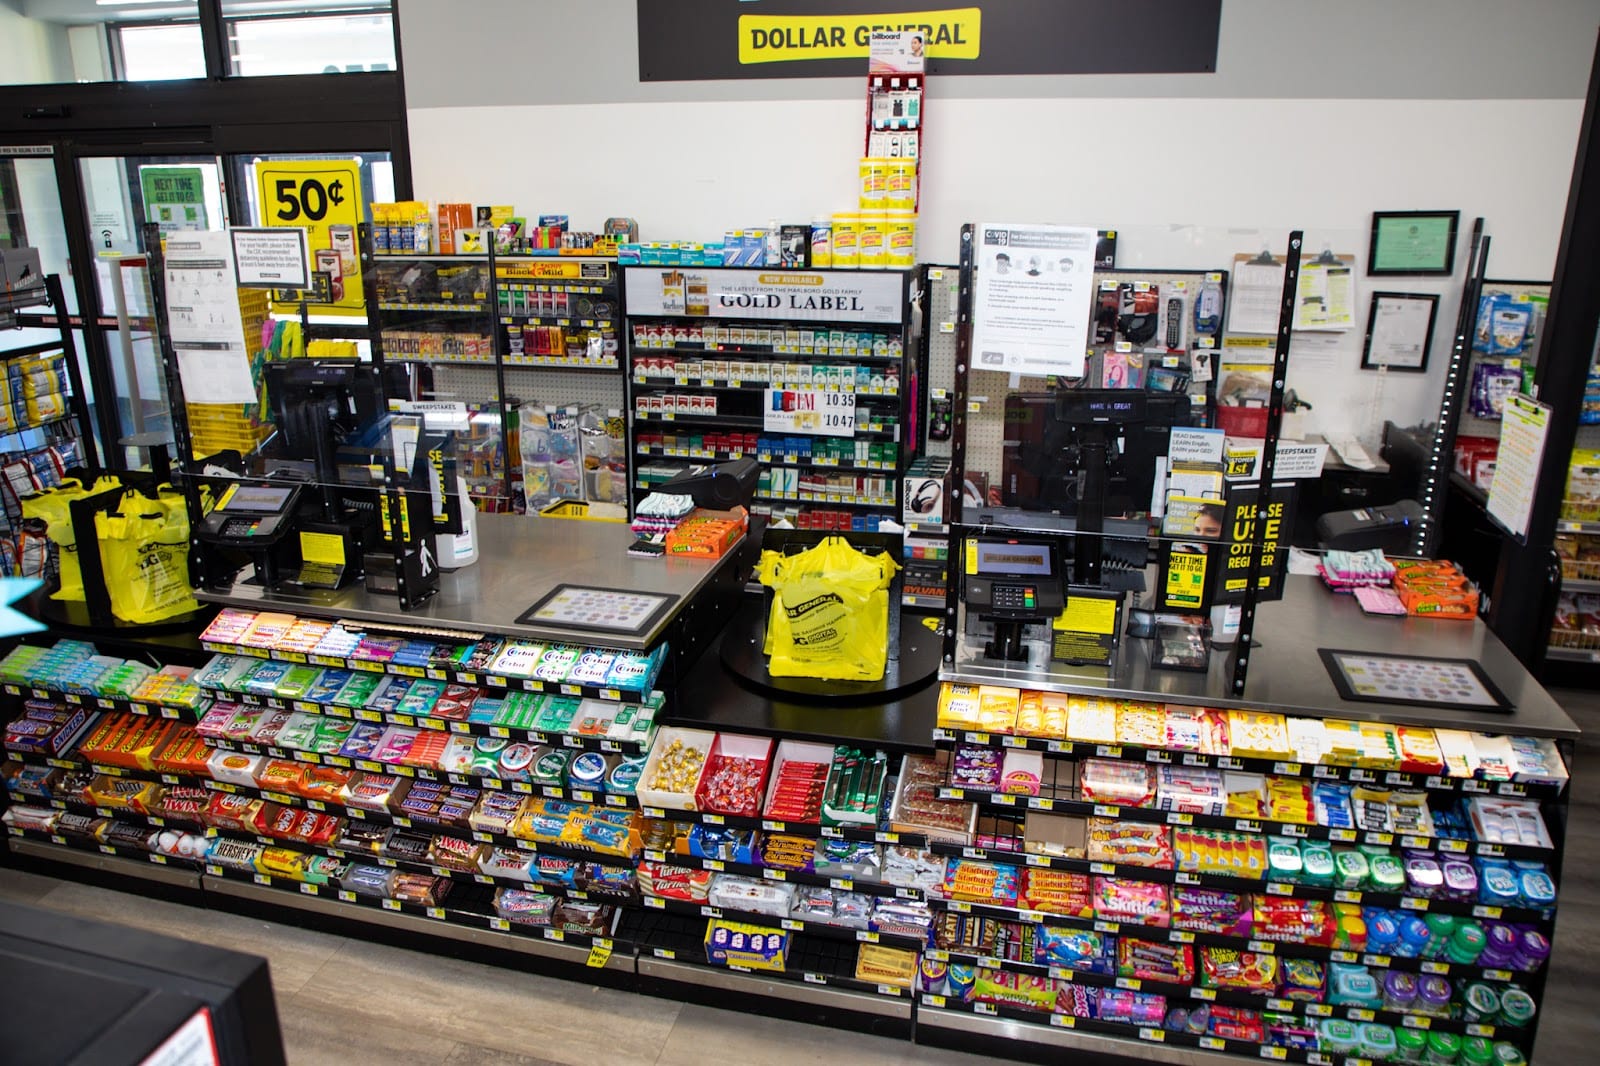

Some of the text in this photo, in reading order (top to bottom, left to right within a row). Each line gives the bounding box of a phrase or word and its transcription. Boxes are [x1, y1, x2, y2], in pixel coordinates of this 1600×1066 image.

[751, 23, 966, 49] DOLLAR GRAL
[154, 178, 193, 190] NEXT TIME
[276, 179, 344, 221] 50¢
[720, 294, 864, 311] GOLD LABEL
[1227, 462, 1247, 474] 1st
[1236, 503, 1284, 520] PLESE
[1230, 542, 1276, 556] OTR
[1170, 555, 1203, 565] NEXT TIME
[1228, 555, 1274, 569] REGIER
[904, 585, 946, 596] SYLVAN
[799, 596, 839, 612] GENERAL
[507, 648, 535, 658] Orbit
[545, 651, 572, 662] Orbit
[621, 648, 650, 659] Orbit
[498, 658, 526, 668] Orbit
[582, 654, 611, 666] Orbit
[254, 670, 282, 679] Extra
[536, 665, 564, 676] Orbit
[573, 665, 601, 676] Orbit
[616, 664, 645, 674] Orbit
[53, 709, 84, 750] SNICKERS
[413, 781, 443, 791] SNICKERS
[451, 786, 479, 797] SNICKERS
[408, 789, 438, 802] SNICKERS
[402, 798, 432, 812] SNICKERS
[487, 796, 518, 808] SNICKERS
[216, 842, 258, 859] HERSHEY'S
[764, 850, 803, 862] Caramello
[539, 856, 567, 868] TWIX
[657, 862, 691, 879] Turtles
[960, 865, 998, 877] Starburst
[1034, 871, 1070, 880] Starburst
[654, 879, 691, 891] Turtles
[957, 874, 994, 886] Starburst
[1032, 880, 1070, 889] Starburst
[955, 882, 992, 896] Starburst
[1032, 890, 1069, 900] Starburst
